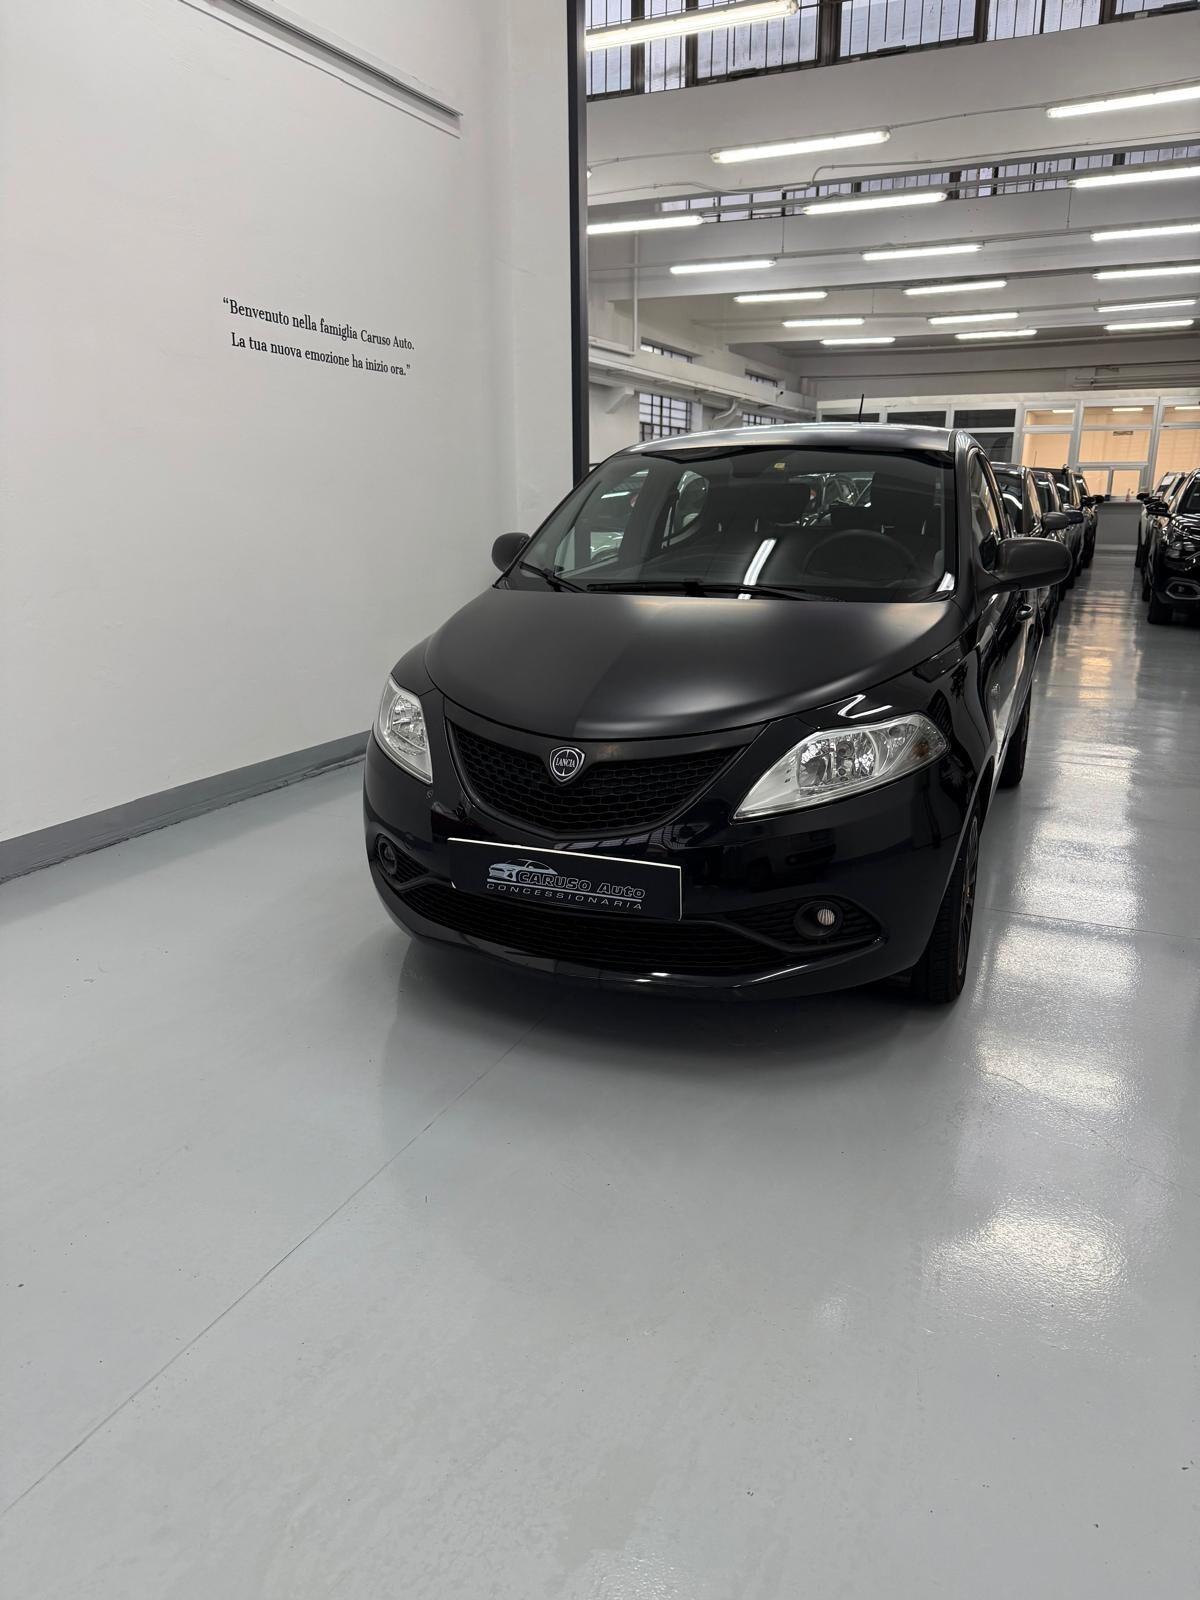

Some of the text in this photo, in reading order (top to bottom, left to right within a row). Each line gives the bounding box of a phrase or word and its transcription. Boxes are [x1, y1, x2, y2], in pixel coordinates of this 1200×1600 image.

[292, 314, 317, 331] nella
[320, 318, 358, 341] famiglia
[360, 329, 391, 347] Caruso
[392, 335, 415, 350] Auto.
[231, 332, 246, 348] La
[249, 336, 268, 352] tua
[270, 343, 302, 358] nuova
[305, 349, 350, 367] emozione
[352, 354, 363, 369] ha
[365, 358, 389, 373] inizio
[555, 757, 576, 768] LANCIA
[517, 871, 592, 892] CARUSO
[486, 883, 643, 910] CONCESSIONARIA
